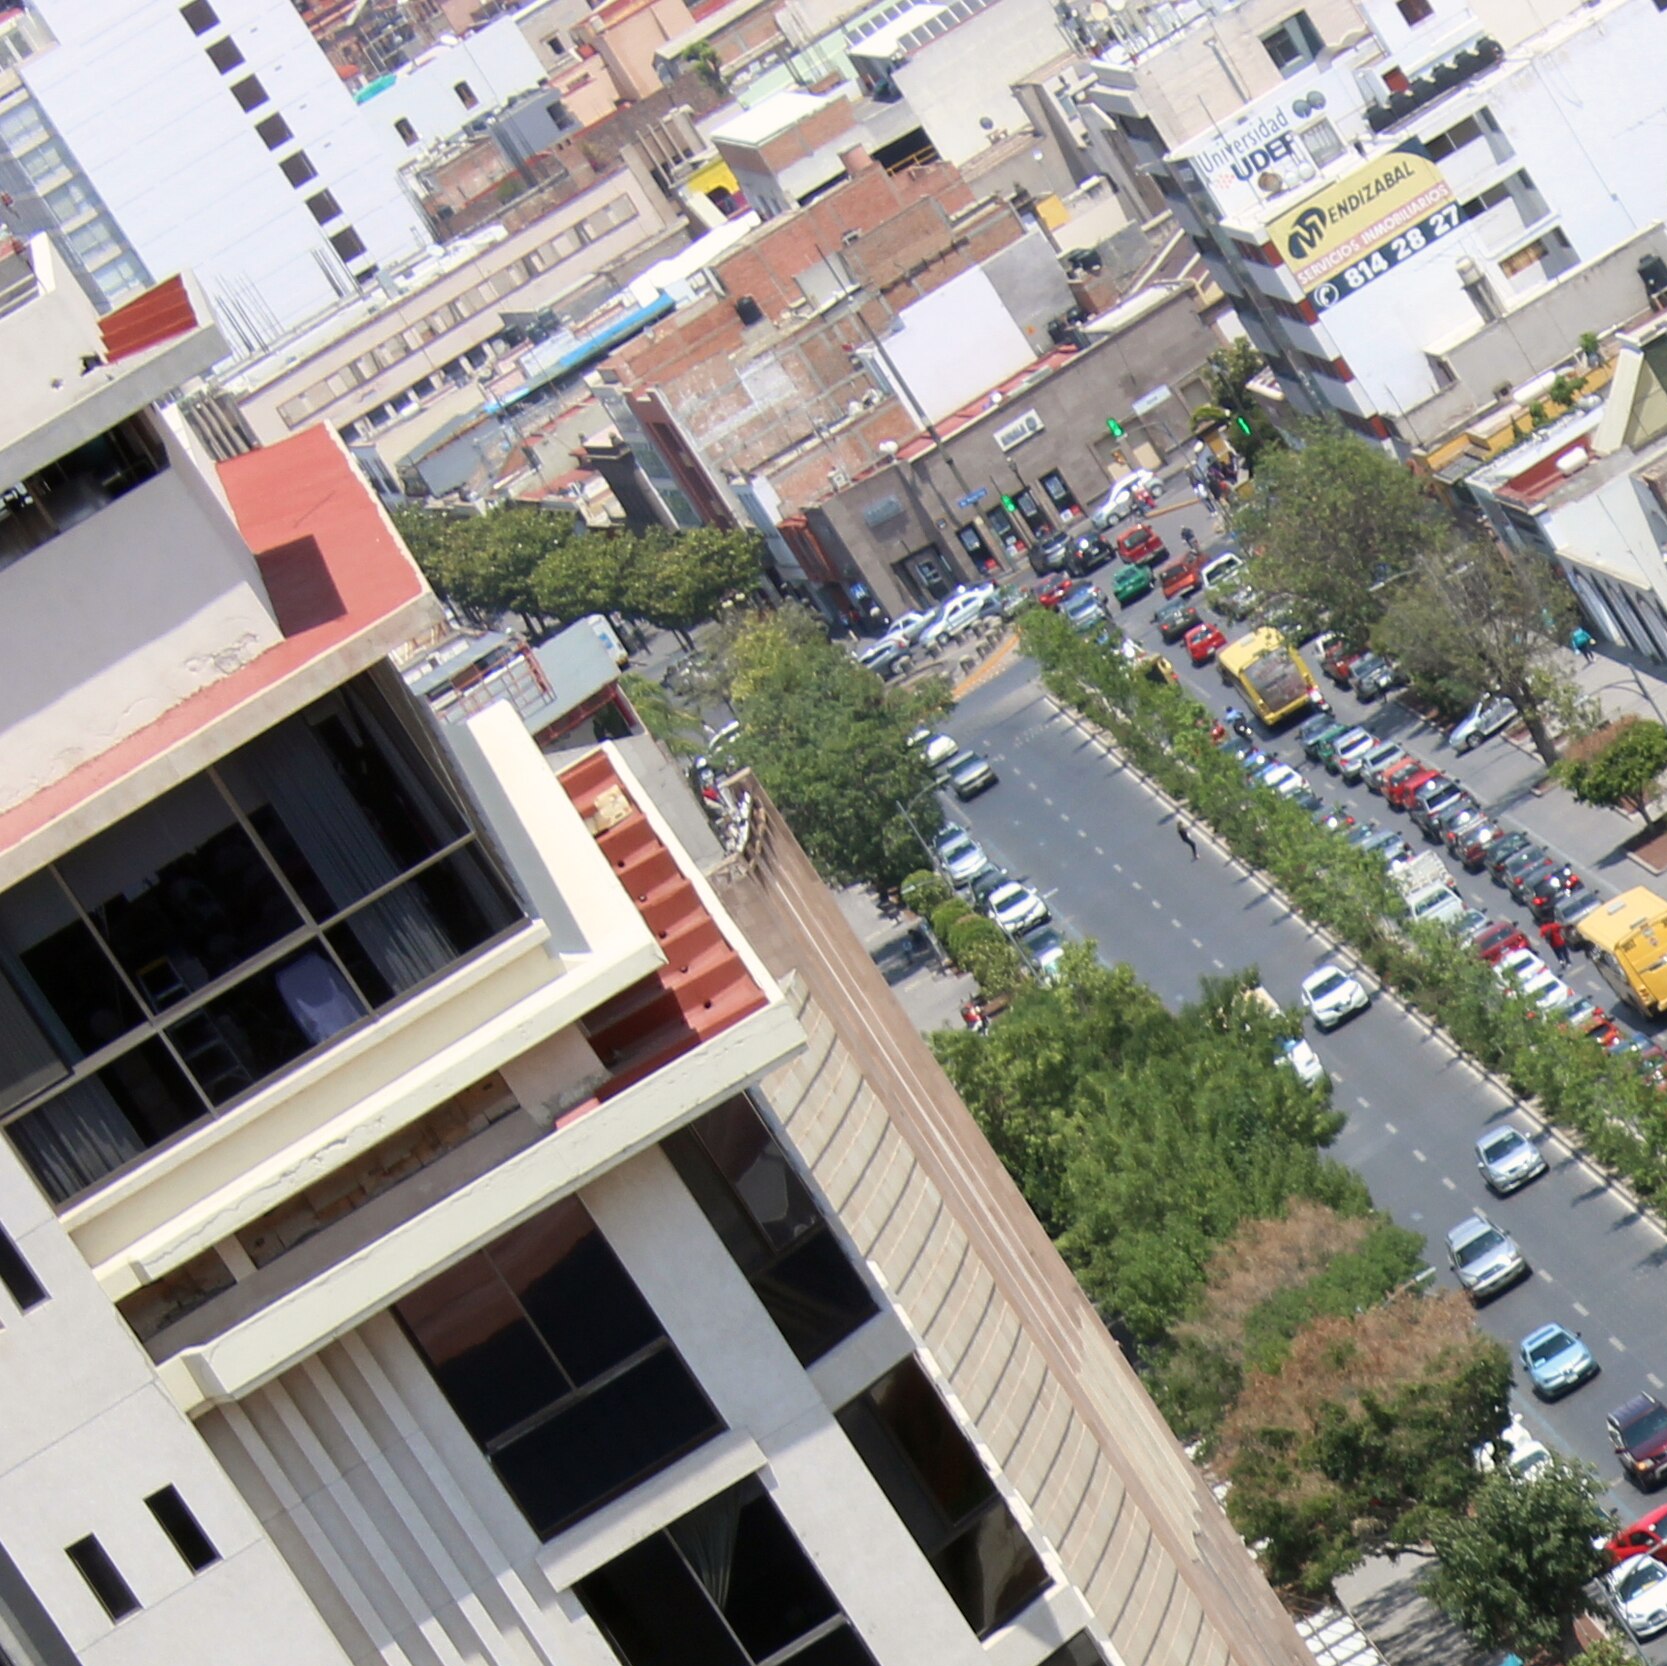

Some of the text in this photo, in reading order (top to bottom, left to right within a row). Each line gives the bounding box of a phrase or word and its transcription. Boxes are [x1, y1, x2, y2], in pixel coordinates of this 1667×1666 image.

[1198, 106, 1289, 174] Universidad
[1288, 160, 1415, 260] MENDIZABAL
[1297, 182, 1450, 285] SERVICIOS INMOBILIARIOS
[1343, 204, 1461, 289] 814 28 27
